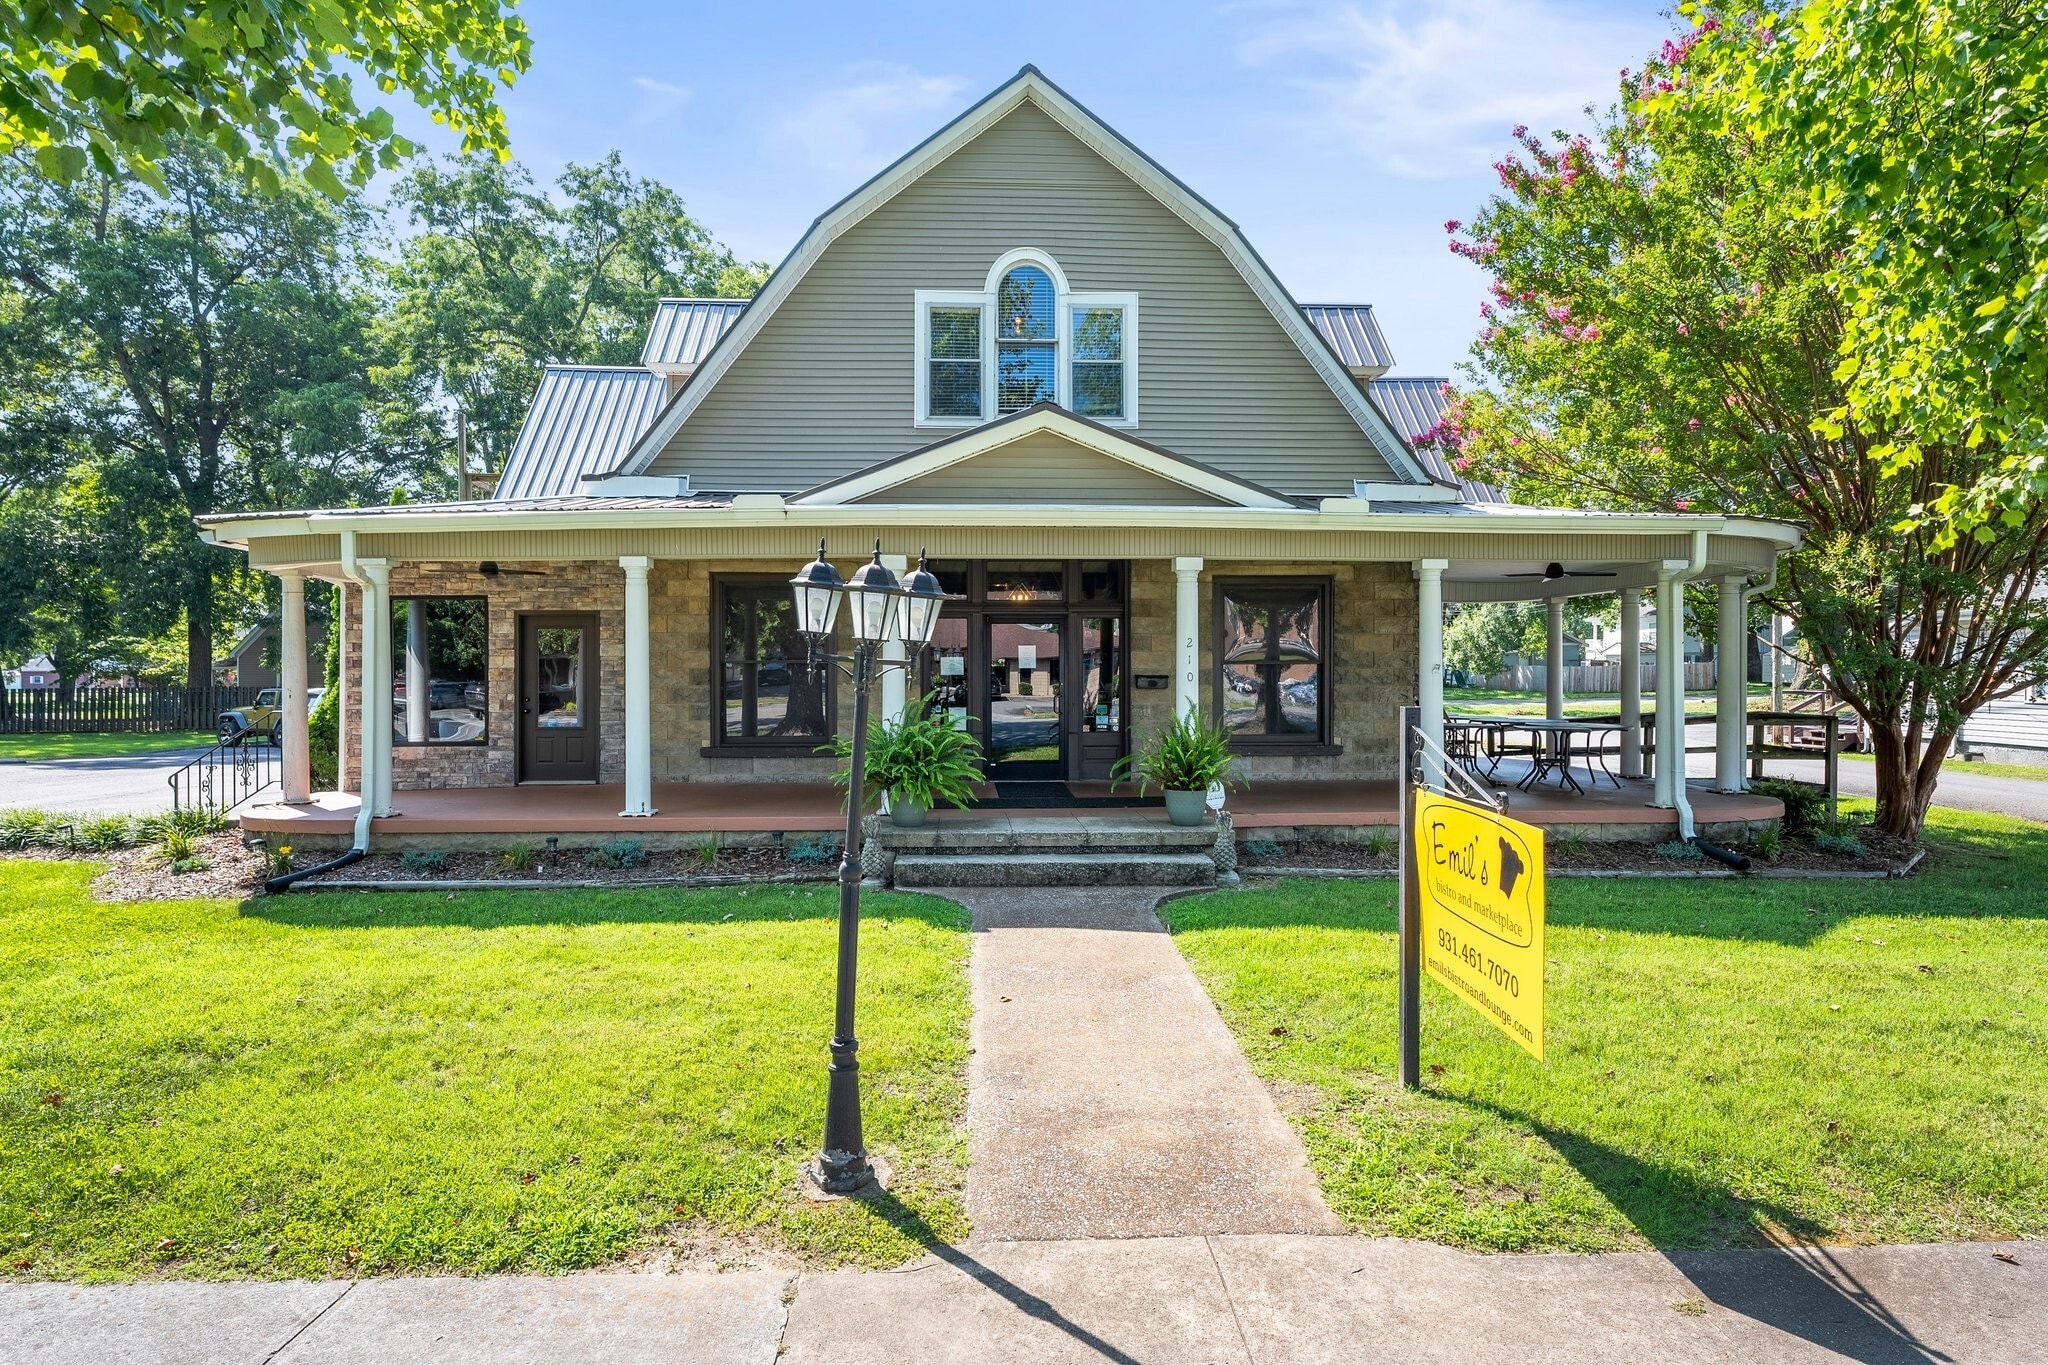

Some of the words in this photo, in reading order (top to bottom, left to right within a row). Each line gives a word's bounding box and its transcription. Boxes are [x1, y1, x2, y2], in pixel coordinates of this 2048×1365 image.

[1186, 637, 1194, 682] 210
[1432, 821, 1488, 885] Emil's
[1435, 877, 1457, 900] bistro
[1458, 893, 1472, 908] and
[1474, 901, 1523, 937] marketplace
[1438, 928, 1519, 998] 931.461.7070
[1428, 957, 1534, 1044] emilsbistroandlounge.com
